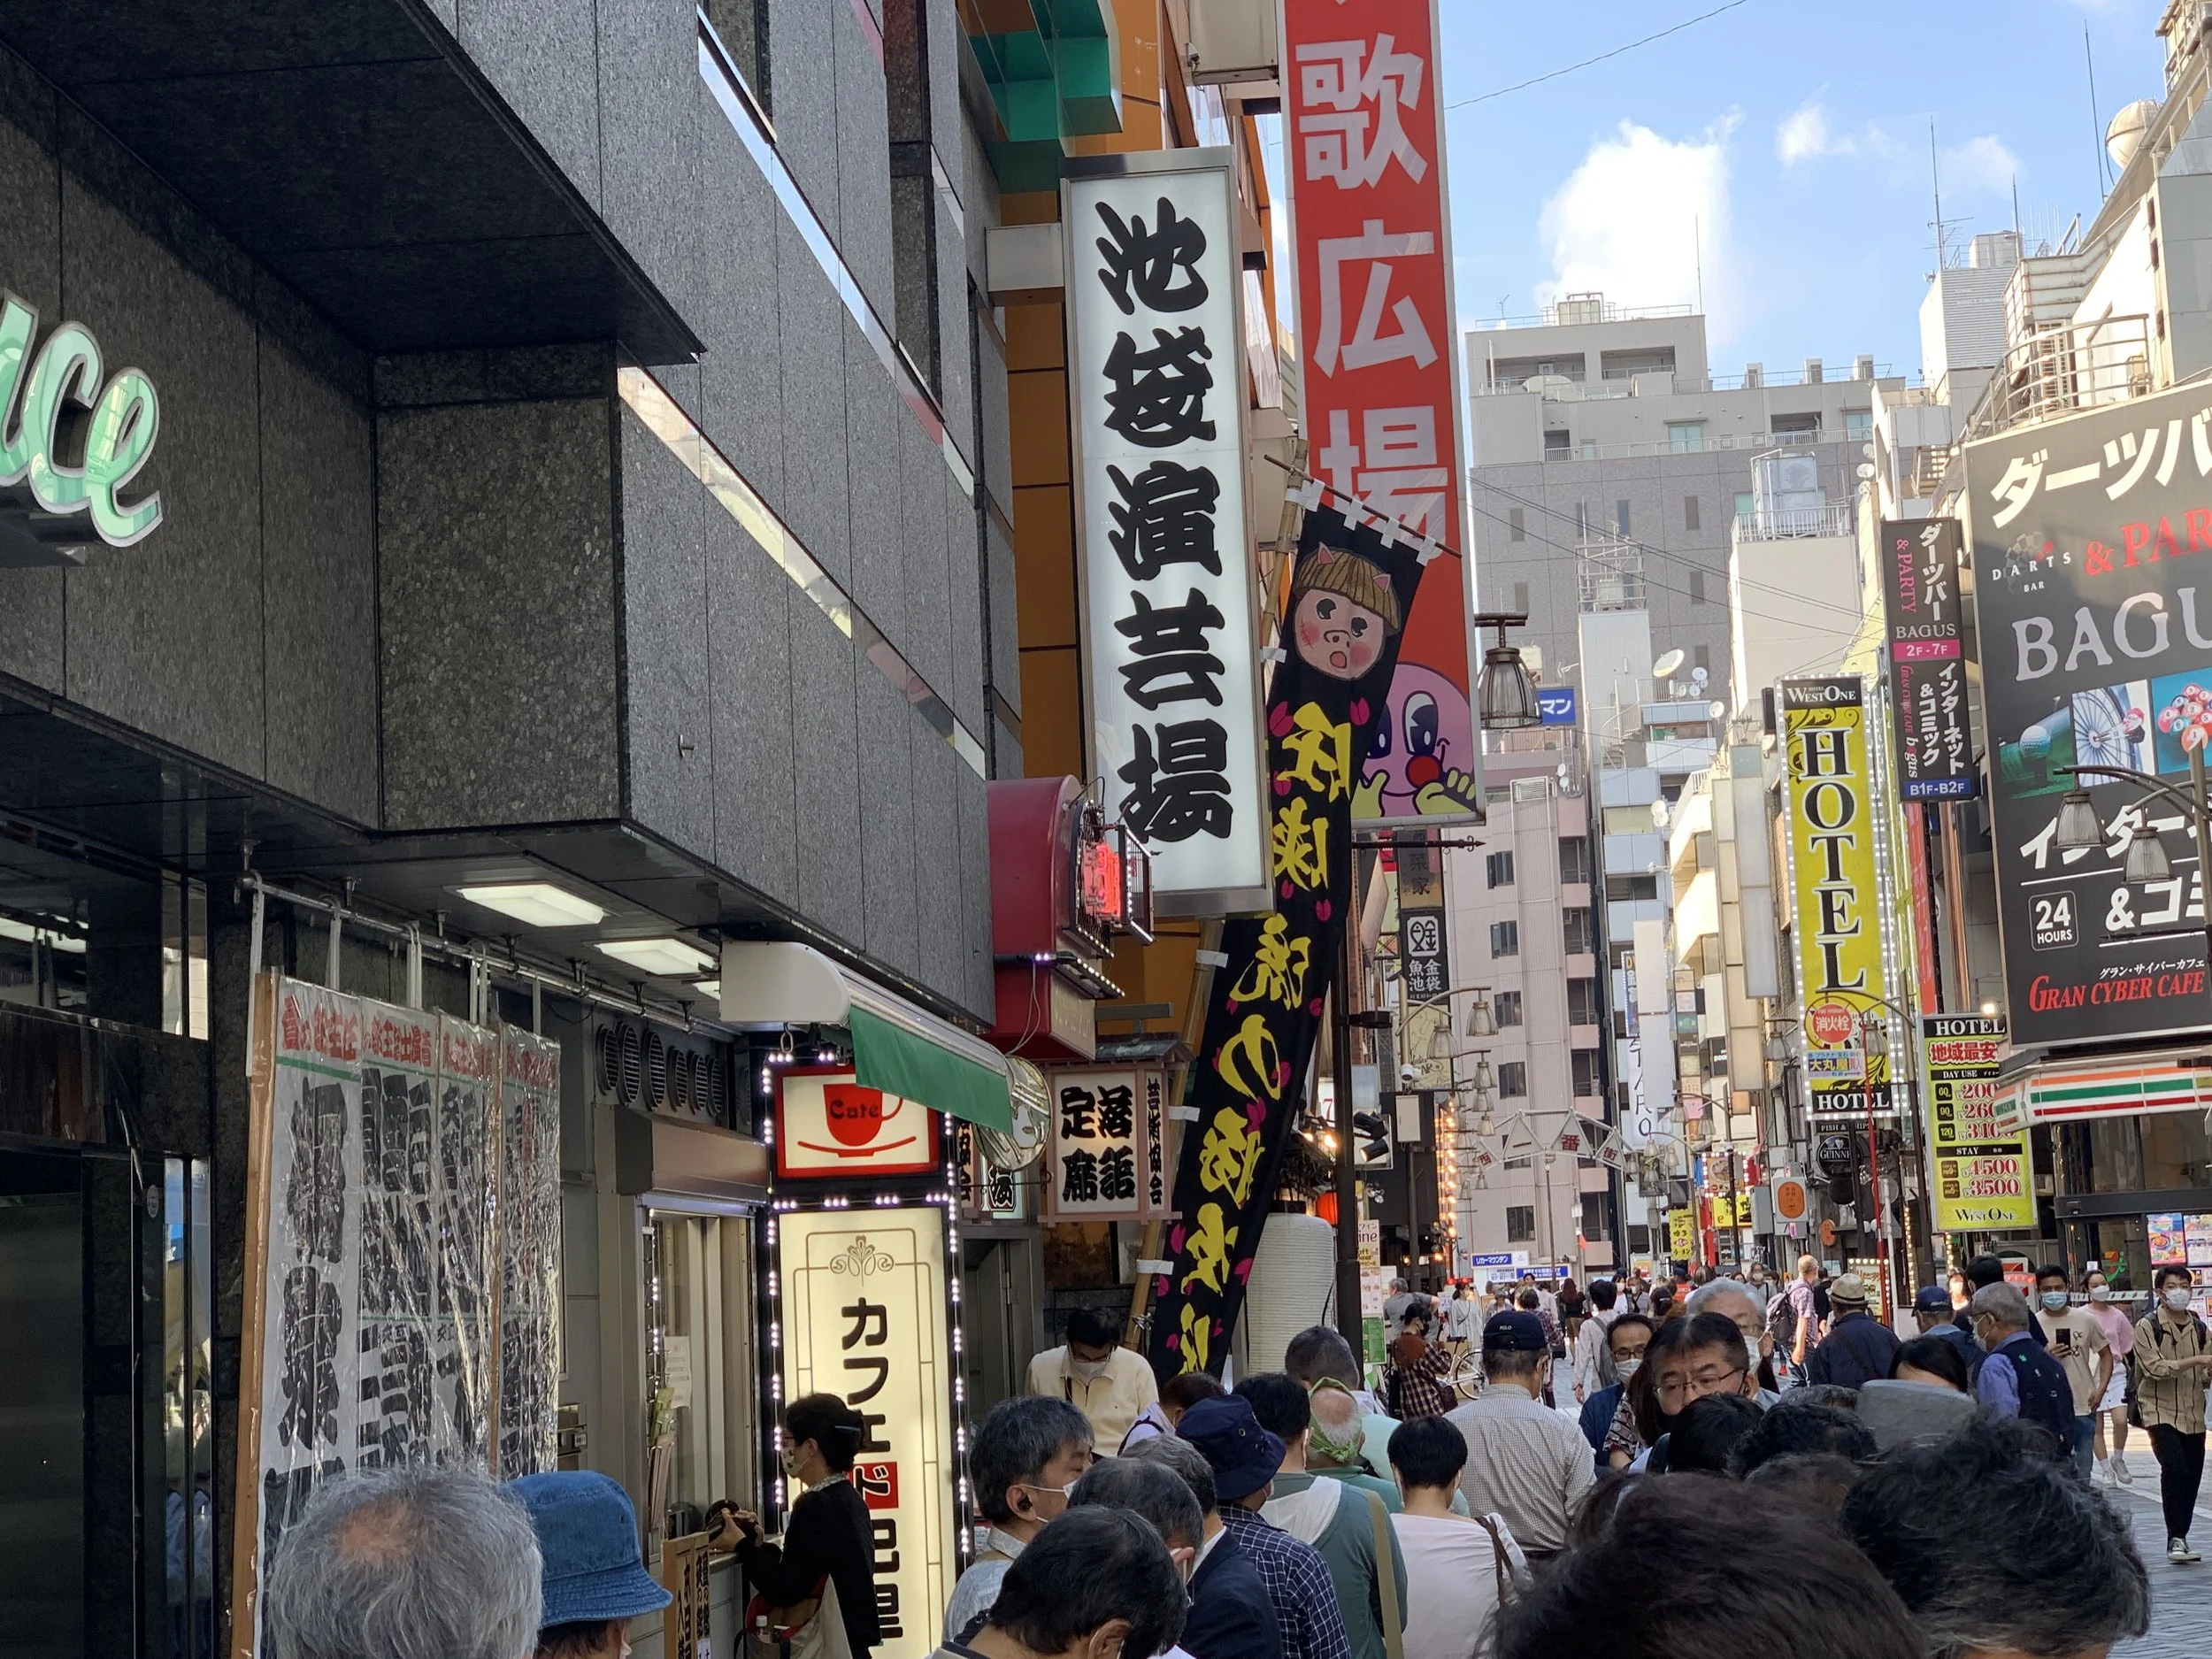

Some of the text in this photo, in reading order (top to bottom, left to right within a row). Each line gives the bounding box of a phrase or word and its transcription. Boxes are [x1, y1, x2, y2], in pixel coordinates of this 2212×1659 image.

[1294, 32, 1448, 557] 歌広場
[1094, 196, 1232, 842] 池袋演芸場
[1919, 523, 1948, 621] ダーツバー
[1992, 552, 2071, 581] DARTS
[1897, 552, 1916, 614] PARTY
[2024, 581, 2045, 593] BAR
[1895, 623, 1957, 639] BAGUS
[1939, 662, 1965, 775] インターネット
[1910, 781, 1964, 795] B1F-B2F
[1798, 728, 1866, 990] HOTEL
[2035, 896, 2071, 931] 24
[2037, 930, 2072, 943] HOURS
[1409, 959, 1441, 976] 魚金
[2100, 957, 2206, 980] グラン・サイバーカフェ
[1409, 976, 1441, 991] 池袋
[2029, 971, 2206, 1012] GRAN CYBER CAFE
[1816, 1016, 1850, 1033] 消火栓
[1935, 1019, 2006, 1035] HOTEL
[1930, 1040, 1998, 1063] 地域最安
[1816, 1092, 1889, 1110] HOTEL
[1956, 1147, 1979, 1156] STAY
[1358, 1230, 1378, 1243] ine
